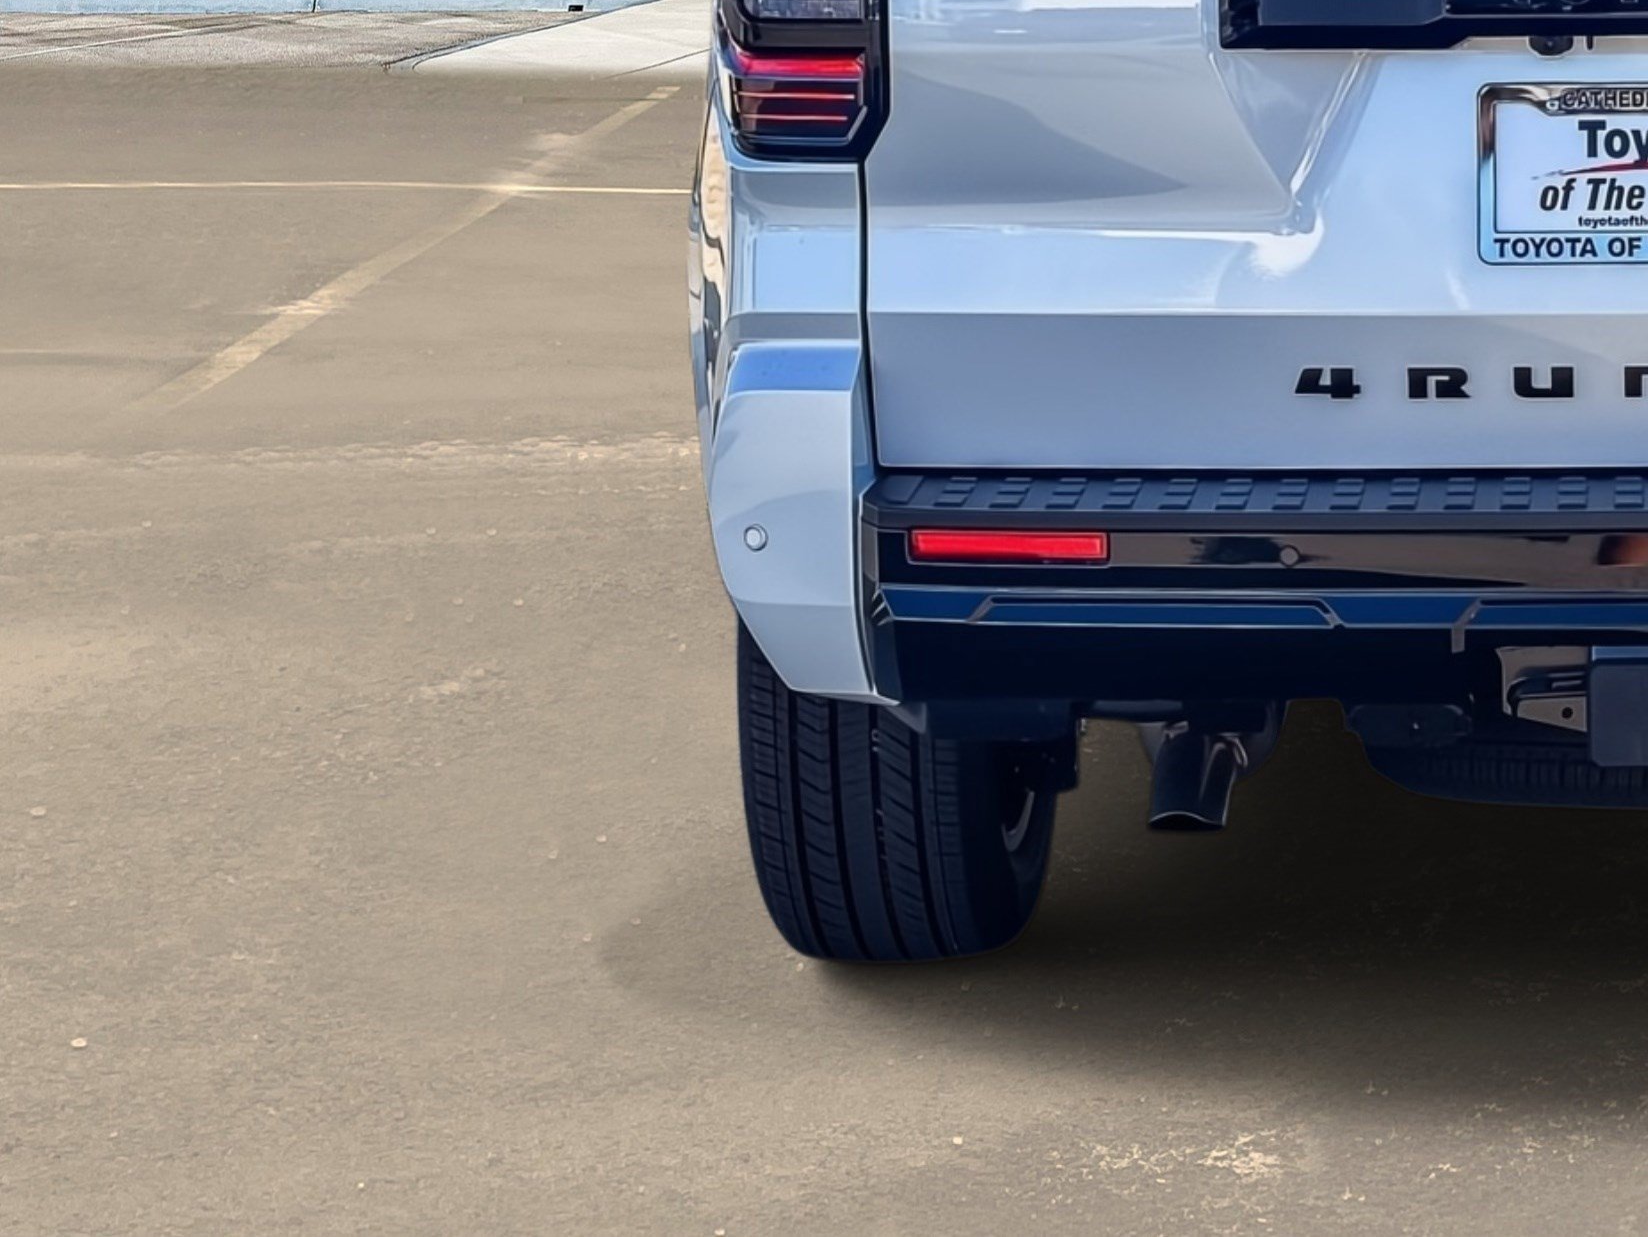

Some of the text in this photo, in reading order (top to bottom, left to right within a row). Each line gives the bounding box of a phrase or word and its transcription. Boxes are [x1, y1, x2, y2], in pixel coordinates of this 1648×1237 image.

[1539, 178, 1575, 212] of
[1585, 178, 1646, 211] The
[1494, 237, 1597, 258] TOYOTA
[1606, 237, 1643, 257] OF
